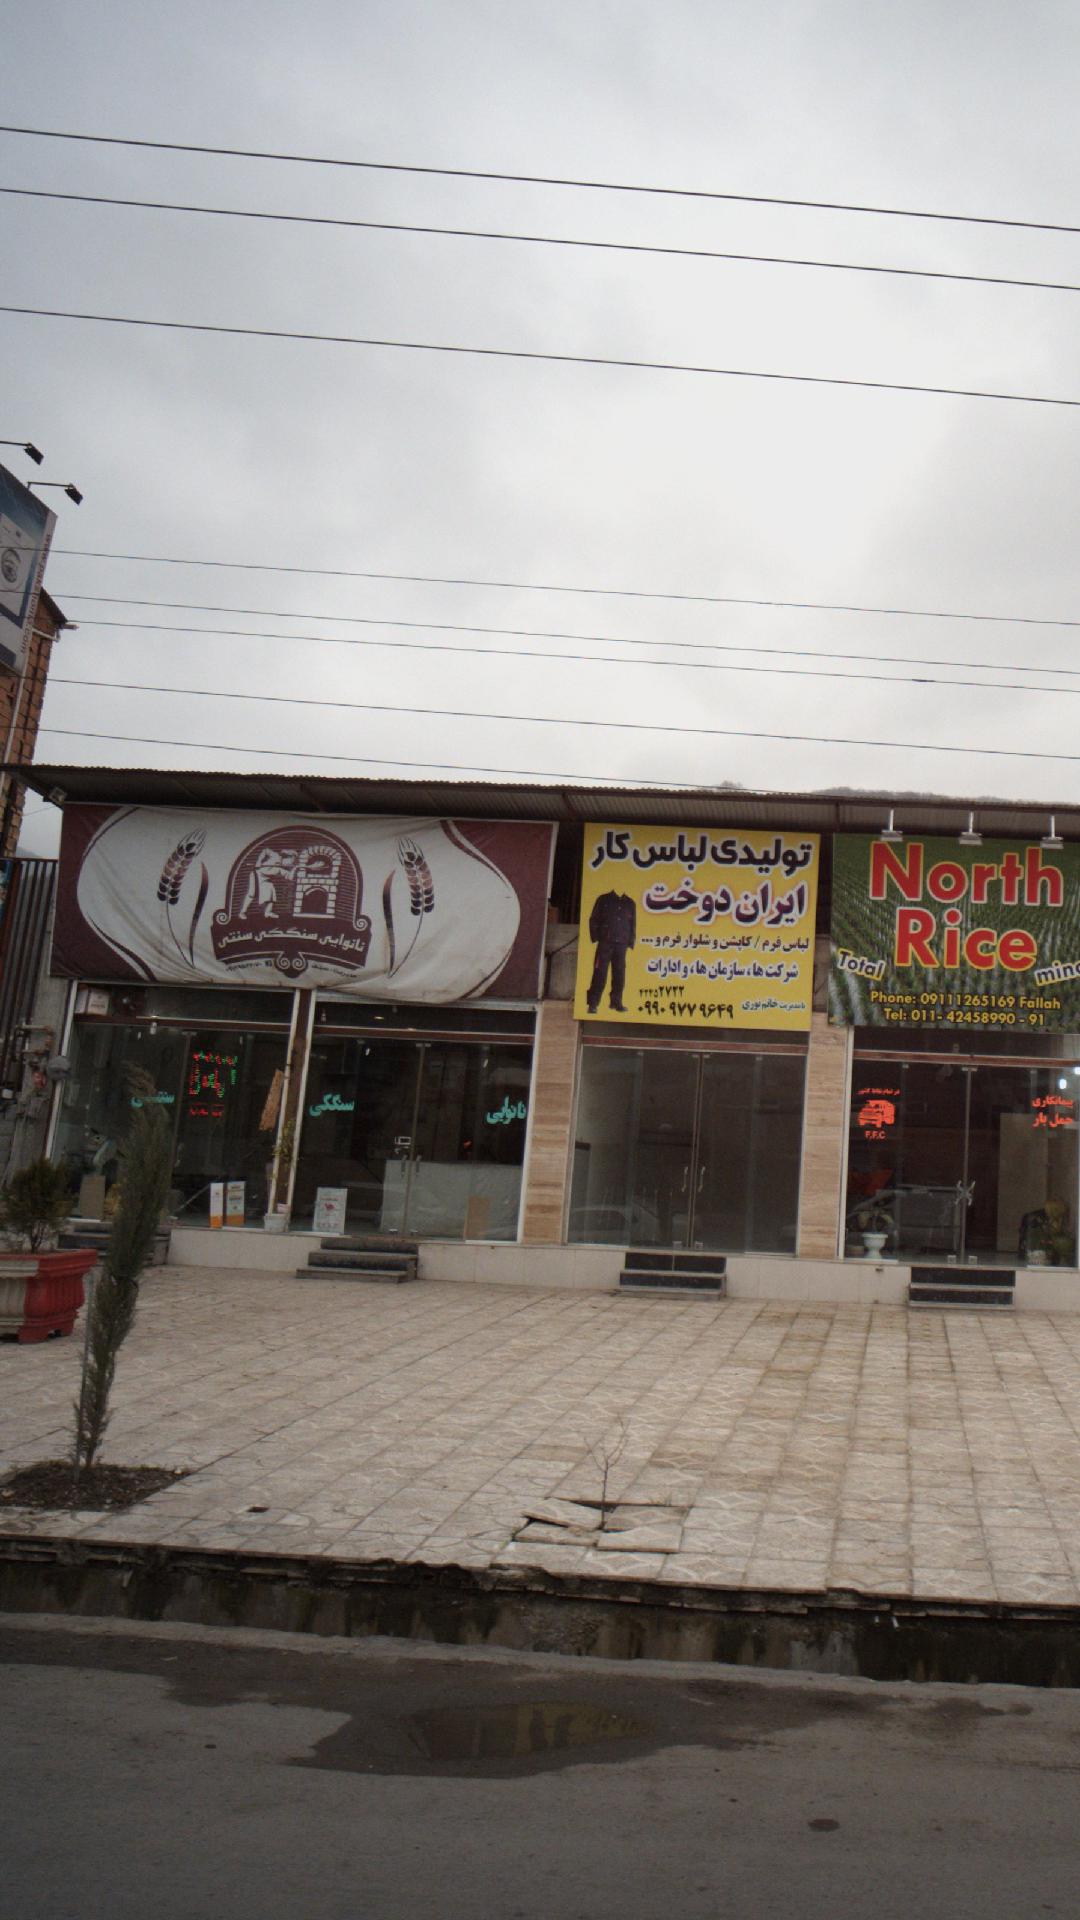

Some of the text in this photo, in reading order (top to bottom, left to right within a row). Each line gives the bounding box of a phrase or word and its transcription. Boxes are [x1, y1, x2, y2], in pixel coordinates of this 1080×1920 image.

[591, 831, 812, 876] تولیدی لباس کار
[869, 842, 1063, 905] North
[645, 880, 806, 925] ایران دوخت
[217, 927, 366, 952] نانوایی سنگکی سنتی
[663, 932, 681, 947] فرم
[684, 934, 710, 949] شلوار
[720, 935, 752, 951] کاپشن
[763, 936, 781, 951] فرم
[783, 938, 809, 952] لباس
[895, 907, 1037, 971] Rice
[648, 959, 681, 978] ادارات
[708, 962, 745, 980] سازمان
[766, 963, 799, 982] شرکت
[838, 949, 885, 981] Total
[870, 991, 1061, 1010] Phone: 09111265169 Fallah
[884, 1008, 907, 1021] Tel:
[946, 1010, 1015, 1024] 42458990
[1028, 1013, 1045, 1025] 91
[309, 1093, 355, 1116] سنگکی
[486, 1096, 527, 1124] نانوایی
